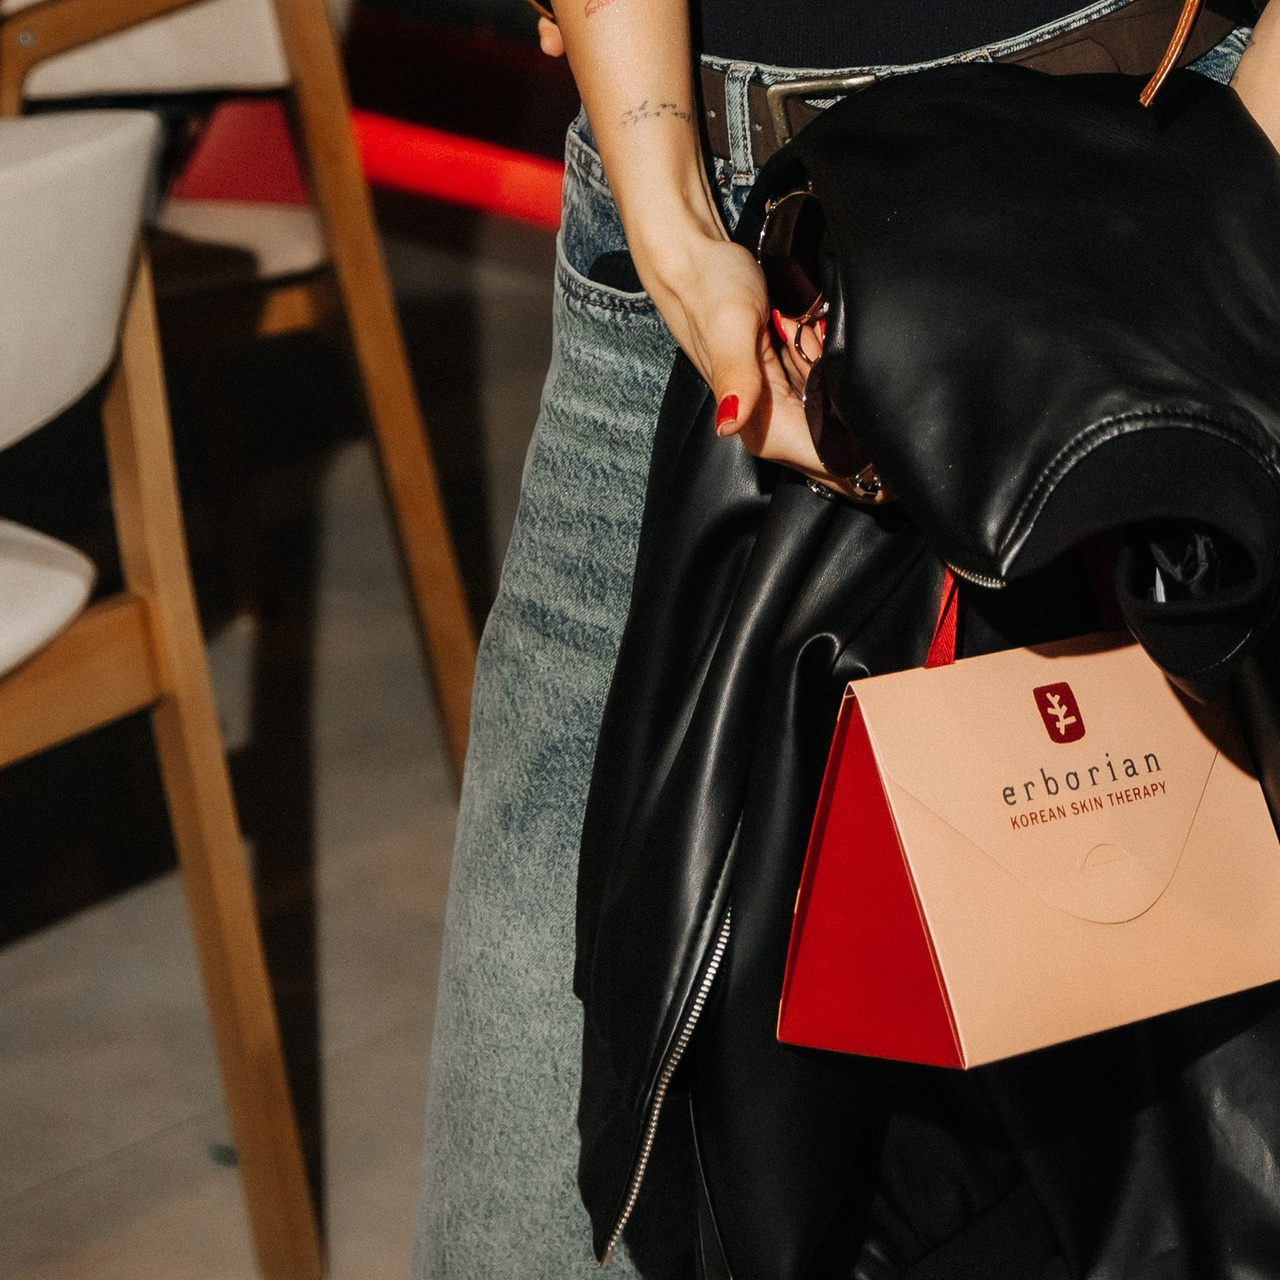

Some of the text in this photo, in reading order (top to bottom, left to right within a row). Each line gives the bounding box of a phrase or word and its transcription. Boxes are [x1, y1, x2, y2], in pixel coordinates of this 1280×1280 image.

[1002, 752, 1162, 806] erborian
[1010, 781, 1167, 831] KOREAN SKIN THERAPY
